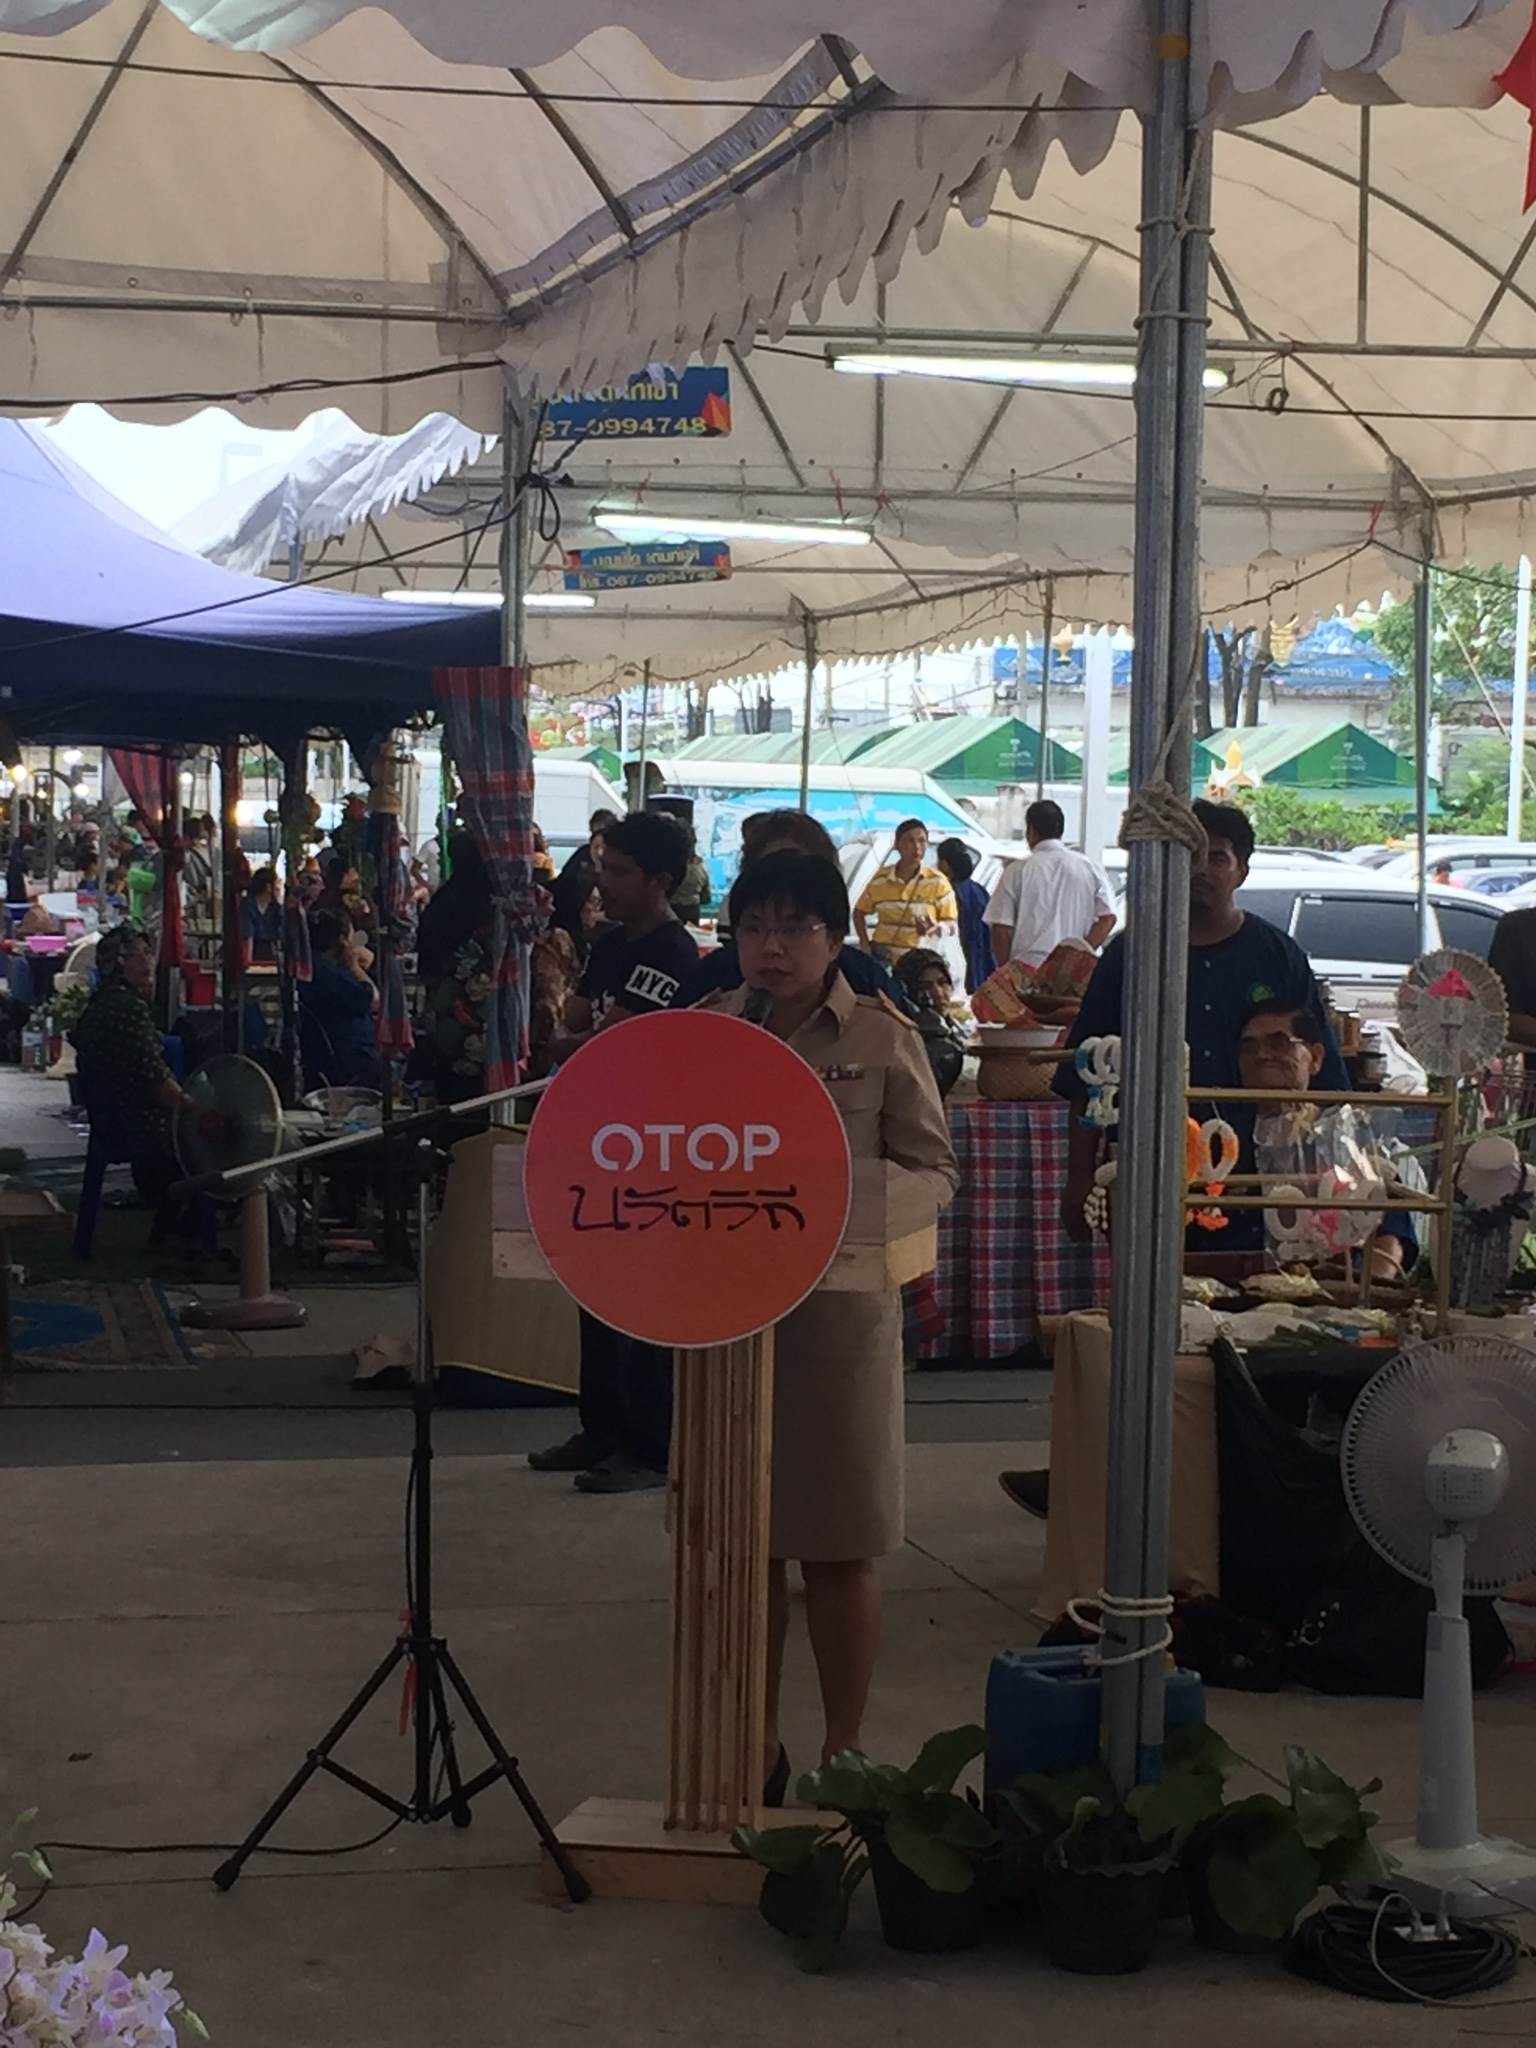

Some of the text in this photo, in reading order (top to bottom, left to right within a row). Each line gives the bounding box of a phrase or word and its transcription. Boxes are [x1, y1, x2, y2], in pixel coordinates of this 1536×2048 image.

[540, 416, 707, 438] 87-0994748
[629, 967, 677, 1004] NYC
[590, 1122, 781, 1172] OTOP
